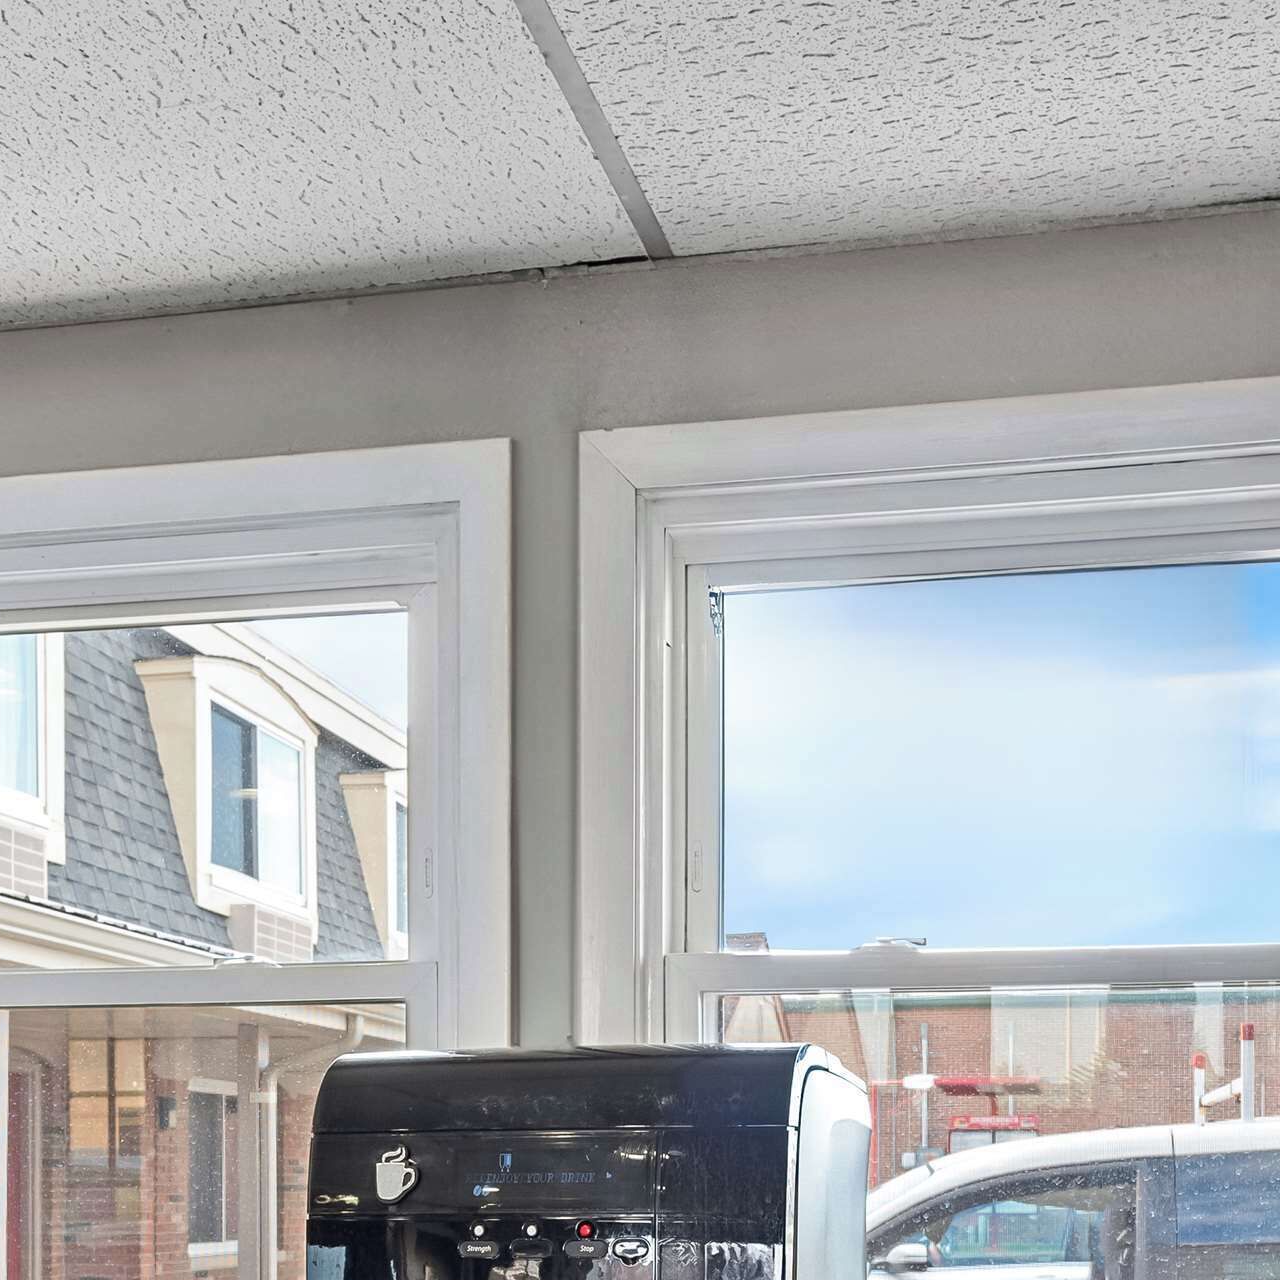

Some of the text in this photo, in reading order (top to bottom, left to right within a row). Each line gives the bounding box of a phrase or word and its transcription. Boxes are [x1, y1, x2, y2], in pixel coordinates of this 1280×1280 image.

[526, 1172, 556, 1184] YOUR
[560, 1172, 596, 1184] DRINK
[466, 1244, 492, 1253] Strength
[579, 1244, 595, 1253] Stop
